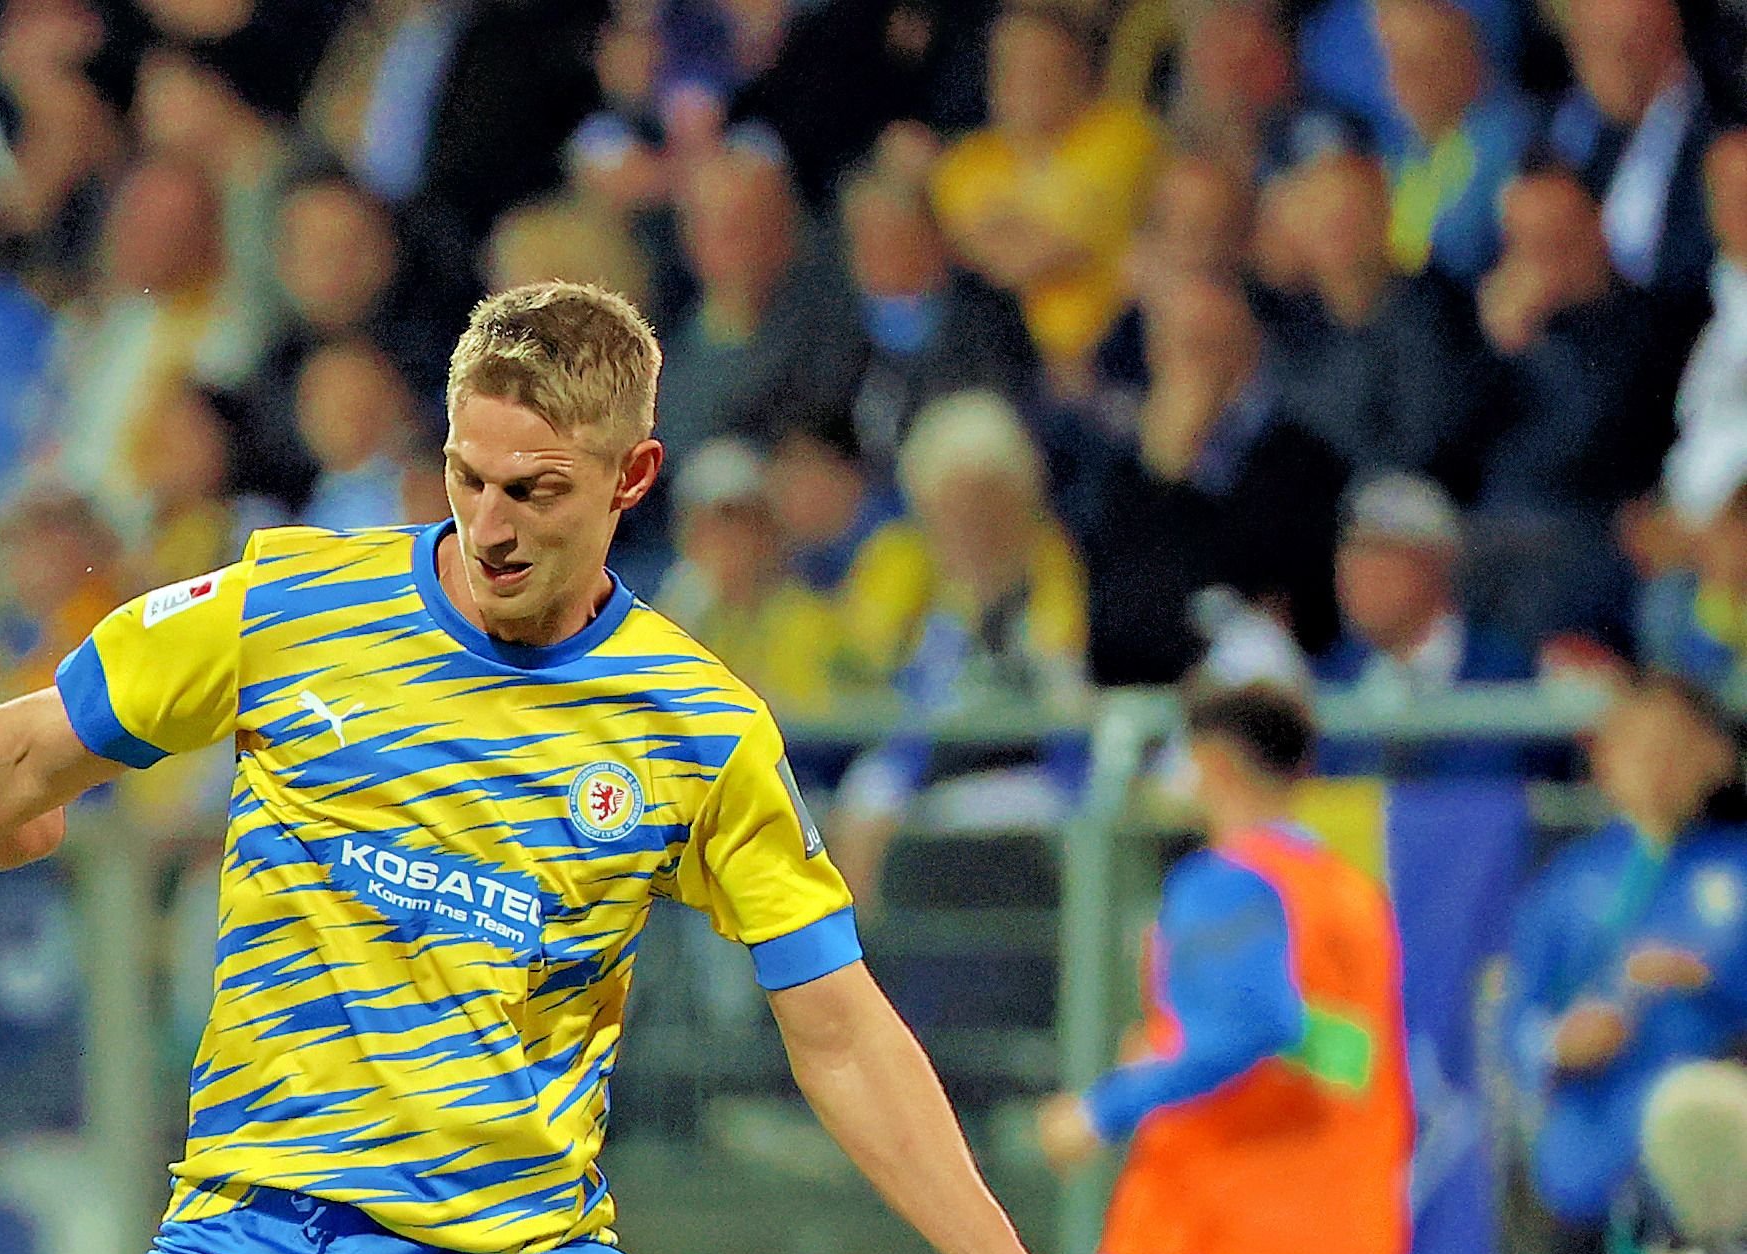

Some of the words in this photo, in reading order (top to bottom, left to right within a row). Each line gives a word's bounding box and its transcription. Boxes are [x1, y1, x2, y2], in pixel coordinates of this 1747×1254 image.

[368, 879, 431, 912] Komm
[434, 898, 467, 923] ins
[472, 910, 525, 945] Team
